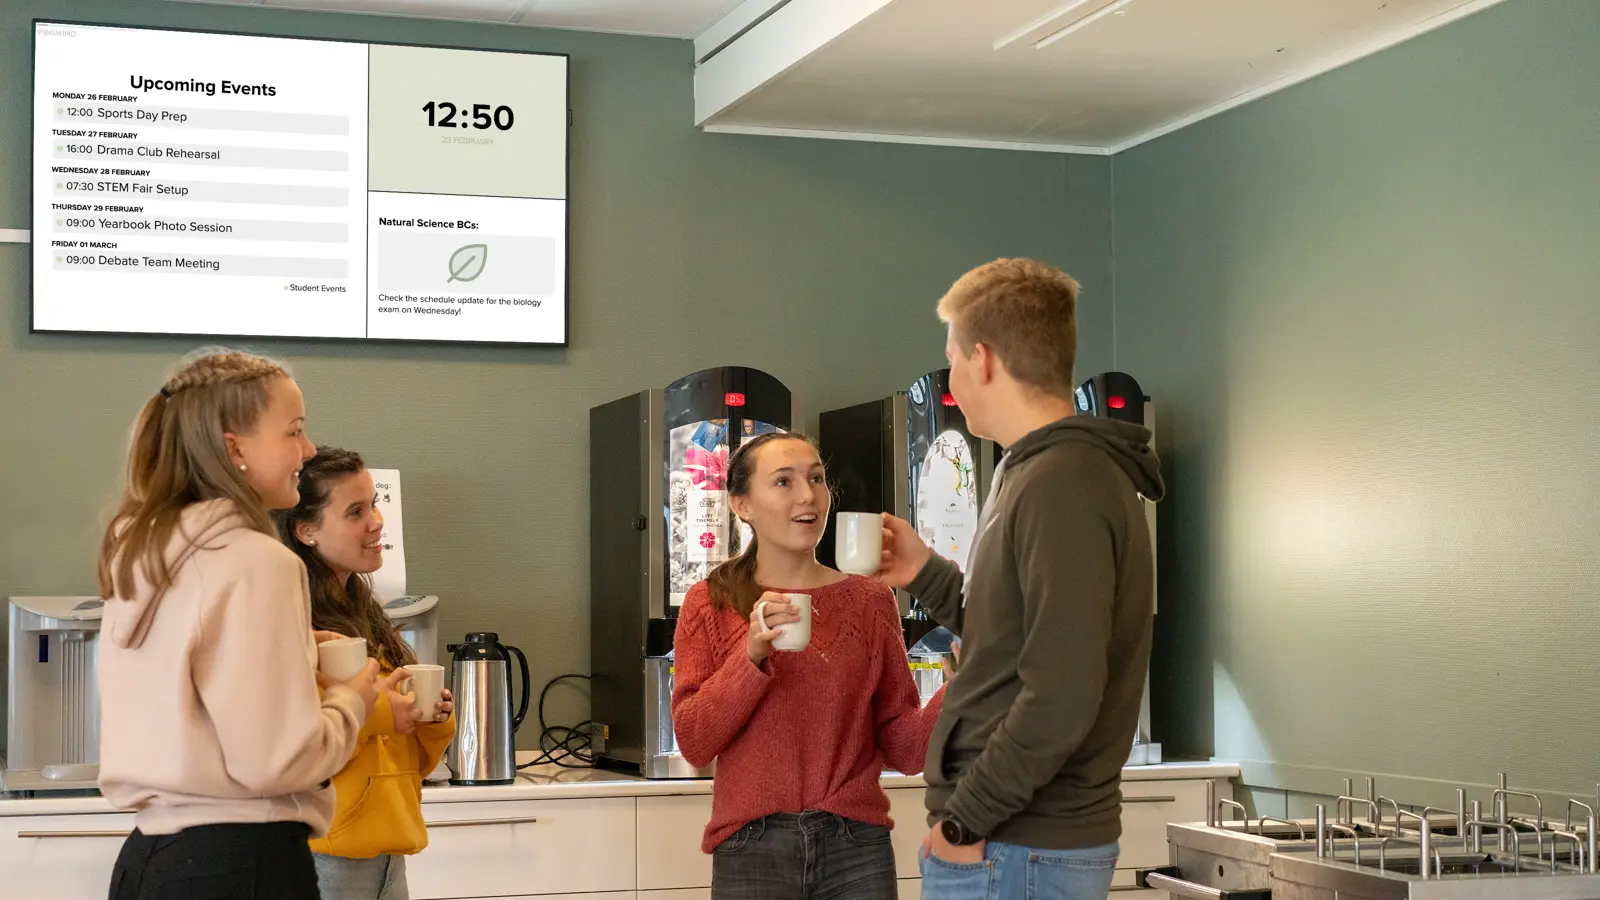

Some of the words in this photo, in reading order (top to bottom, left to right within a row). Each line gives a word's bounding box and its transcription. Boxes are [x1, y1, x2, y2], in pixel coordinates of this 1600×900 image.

[130, 75, 216, 96] Upcoming
[221, 80, 276, 97] Events
[52, 92, 85, 100] MONDAY
[98, 94, 137, 103] FEBRUARY
[66, 107, 93, 117] 12:00
[97, 108, 133, 121] Sports
[136, 110, 158, 123] Day
[161, 111, 187, 124] Prep
[422, 101, 514, 131] 12:50
[52, 129, 86, 137] TUESDAY
[98, 131, 138, 140] FEBRUARY
[441, 136, 452, 144] 23
[453, 137, 495, 146] FEBRUARY
[66, 144, 93, 154] 16:00
[97, 145, 134, 156] Drama
[137, 146, 163, 158] Club
[166, 147, 220, 160] Rehearsal
[111, 169, 150, 177] FEBRUARY
[66, 182, 94, 192] 07:30
[97, 182, 129, 193] STEM
[132, 183, 153, 194] Fair
[156, 184, 188, 197] Setup
[66, 218, 95, 228] 09:00
[98, 218, 151, 230] Yearbook
[154, 221, 187, 232] Photo
[189, 222, 232, 233] Session
[379, 217, 415, 227] Natural
[417, 218, 454, 229] Science
[456, 220, 479, 230] BCs:
[51, 240, 78, 248] FRIDAY
[66, 255, 95, 265] 09:00
[98, 256, 139, 267] Debate
[142, 257, 172, 268] Team
[175, 258, 220, 271] Meeting
[289, 284, 319, 292] Student
[321, 285, 346, 293] Events
[378, 294, 403, 302] Check
[405, 295, 418, 303] the
[419, 295, 455, 304] schedule
[457, 297, 484, 306] update
[486, 297, 497, 305] for
[498, 297, 511, 306] the
[513, 298, 542, 308] biology
[413, 306, 461, 316] Wednesday!
